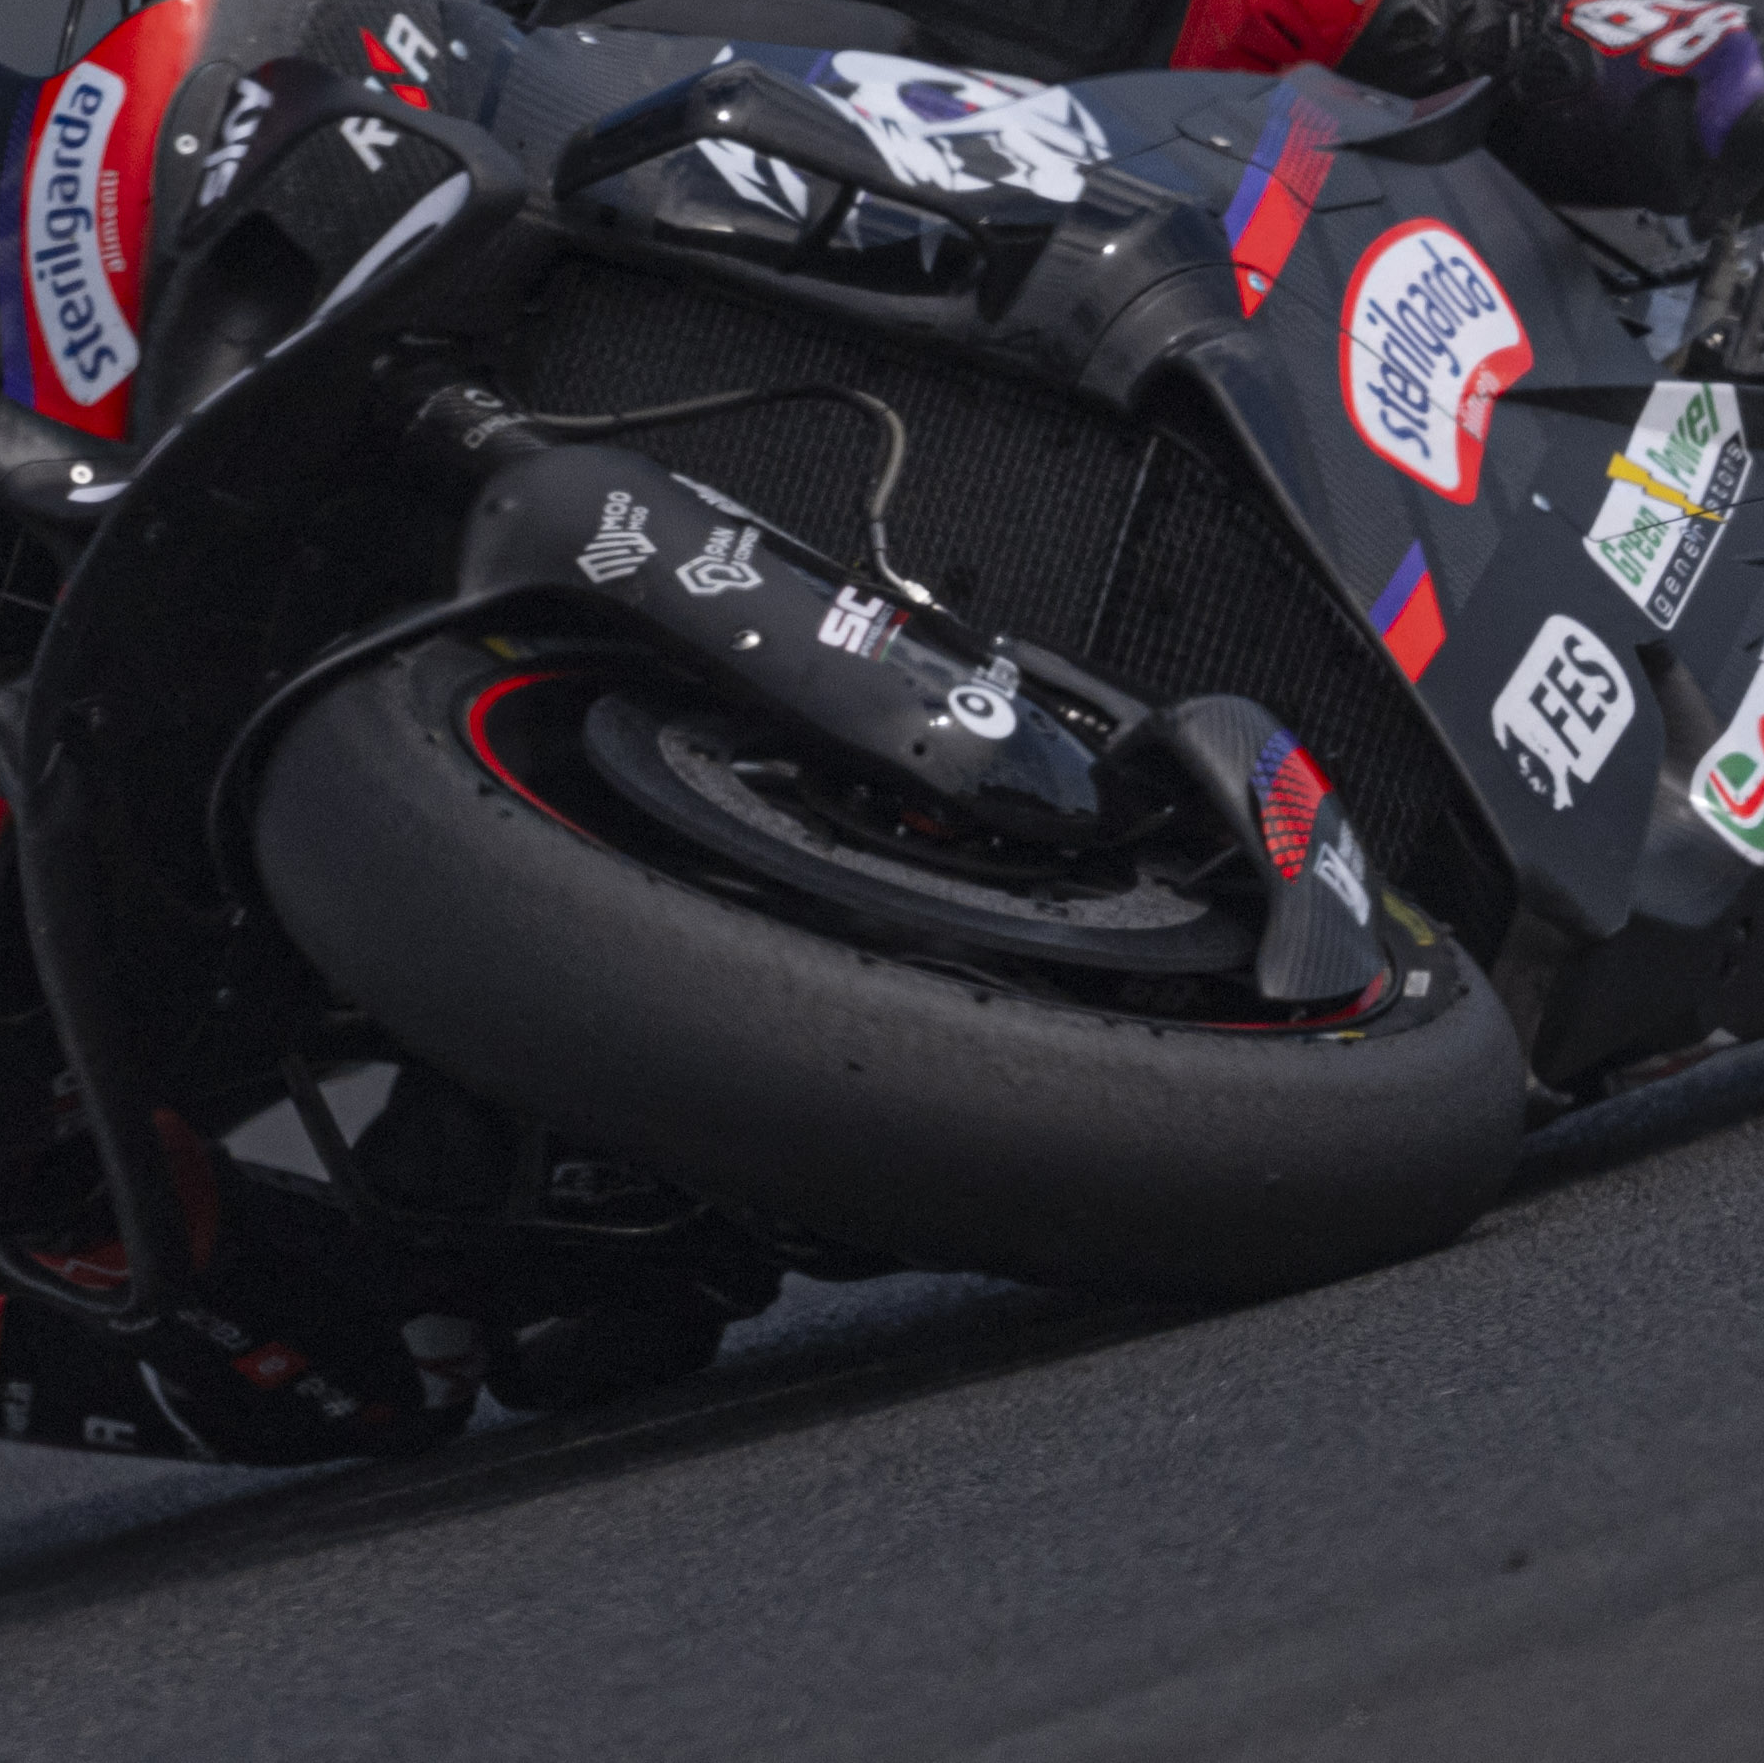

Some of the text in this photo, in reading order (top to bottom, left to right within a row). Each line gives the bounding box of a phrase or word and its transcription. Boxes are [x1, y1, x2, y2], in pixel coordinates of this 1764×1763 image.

[35, 83, 118, 382] sterilgarda
[1366, 239, 1497, 458] sterilgarda
[817, 584, 887, 654] SC
[1599, 504, 1669, 587] Green
